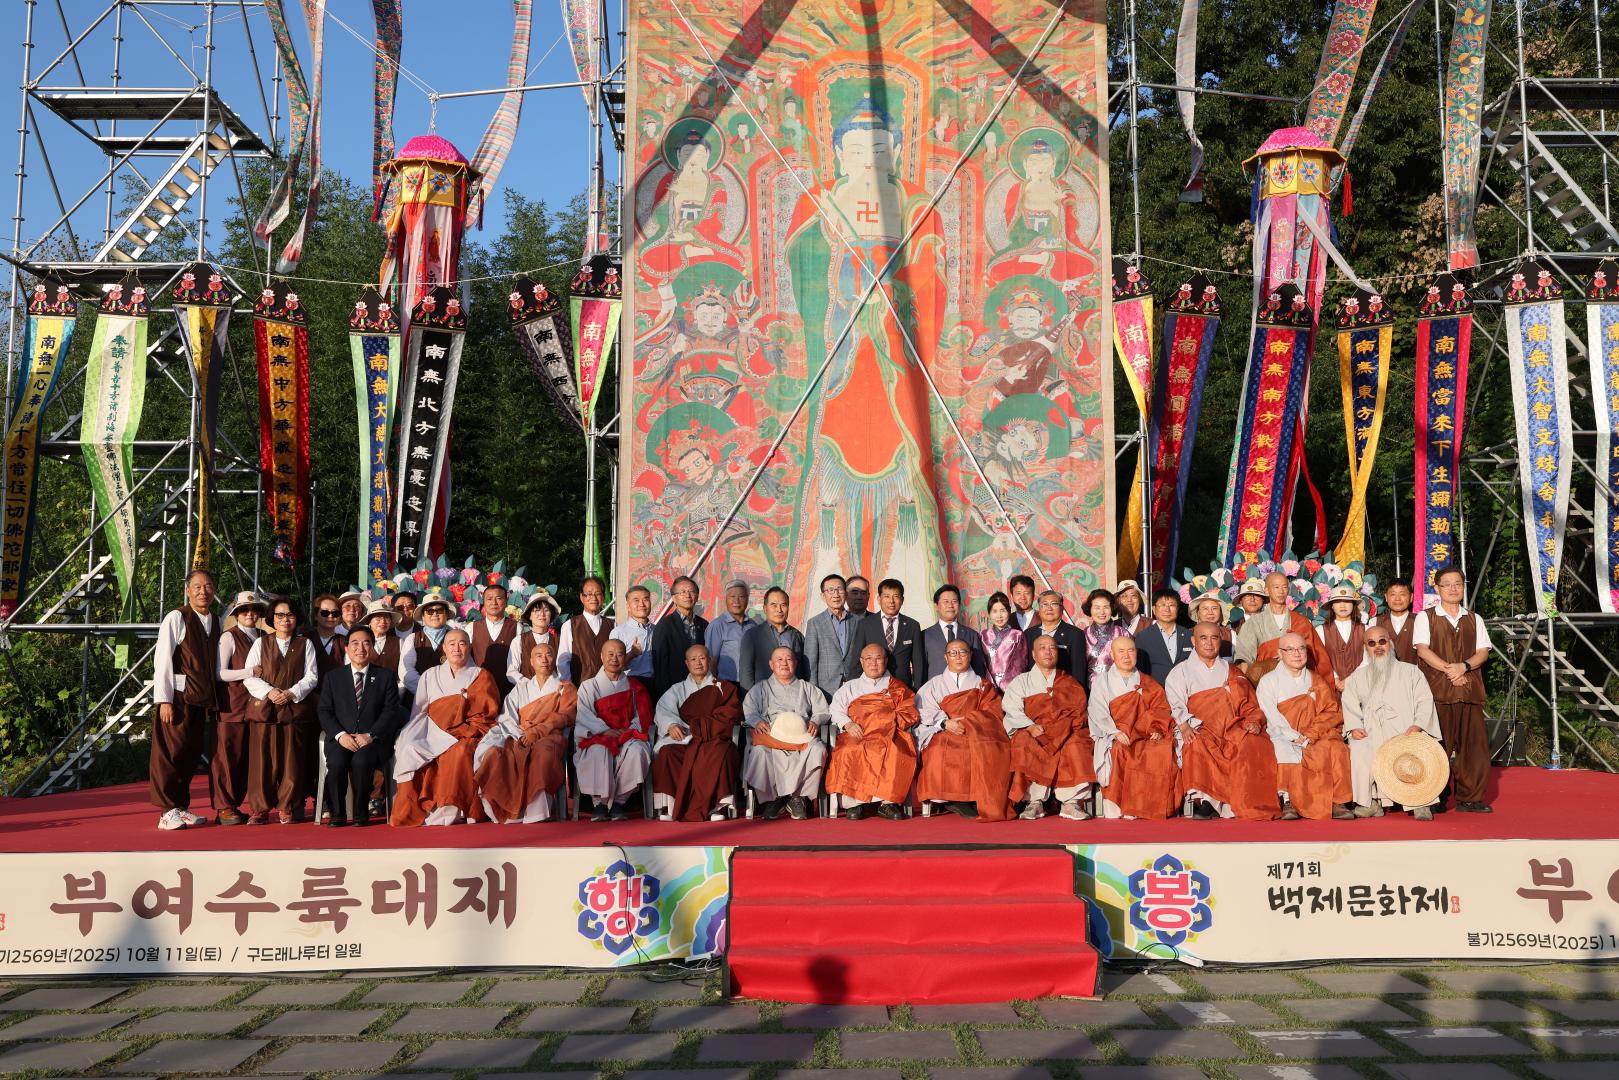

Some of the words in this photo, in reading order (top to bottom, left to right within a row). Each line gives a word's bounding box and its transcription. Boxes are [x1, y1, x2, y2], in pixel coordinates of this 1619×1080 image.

[534, 329, 579, 413] 南無西方
[1267, 861, 1321, 879] 제71회
[49, 861, 518, 936] 부여수륙대재
[588, 877, 642, 936] 행
[1144, 872, 1195, 929] 봉
[1267, 884, 1449, 919] 백제문화제
[127, 947, 160, 962] 10월
[166, 946, 222, 962] 11일(토)
[247, 944, 329, 962] 구드래나루터
[334, 943, 362, 959] 일원
[1467, 932, 1604, 950] 불기2569년(2025)
